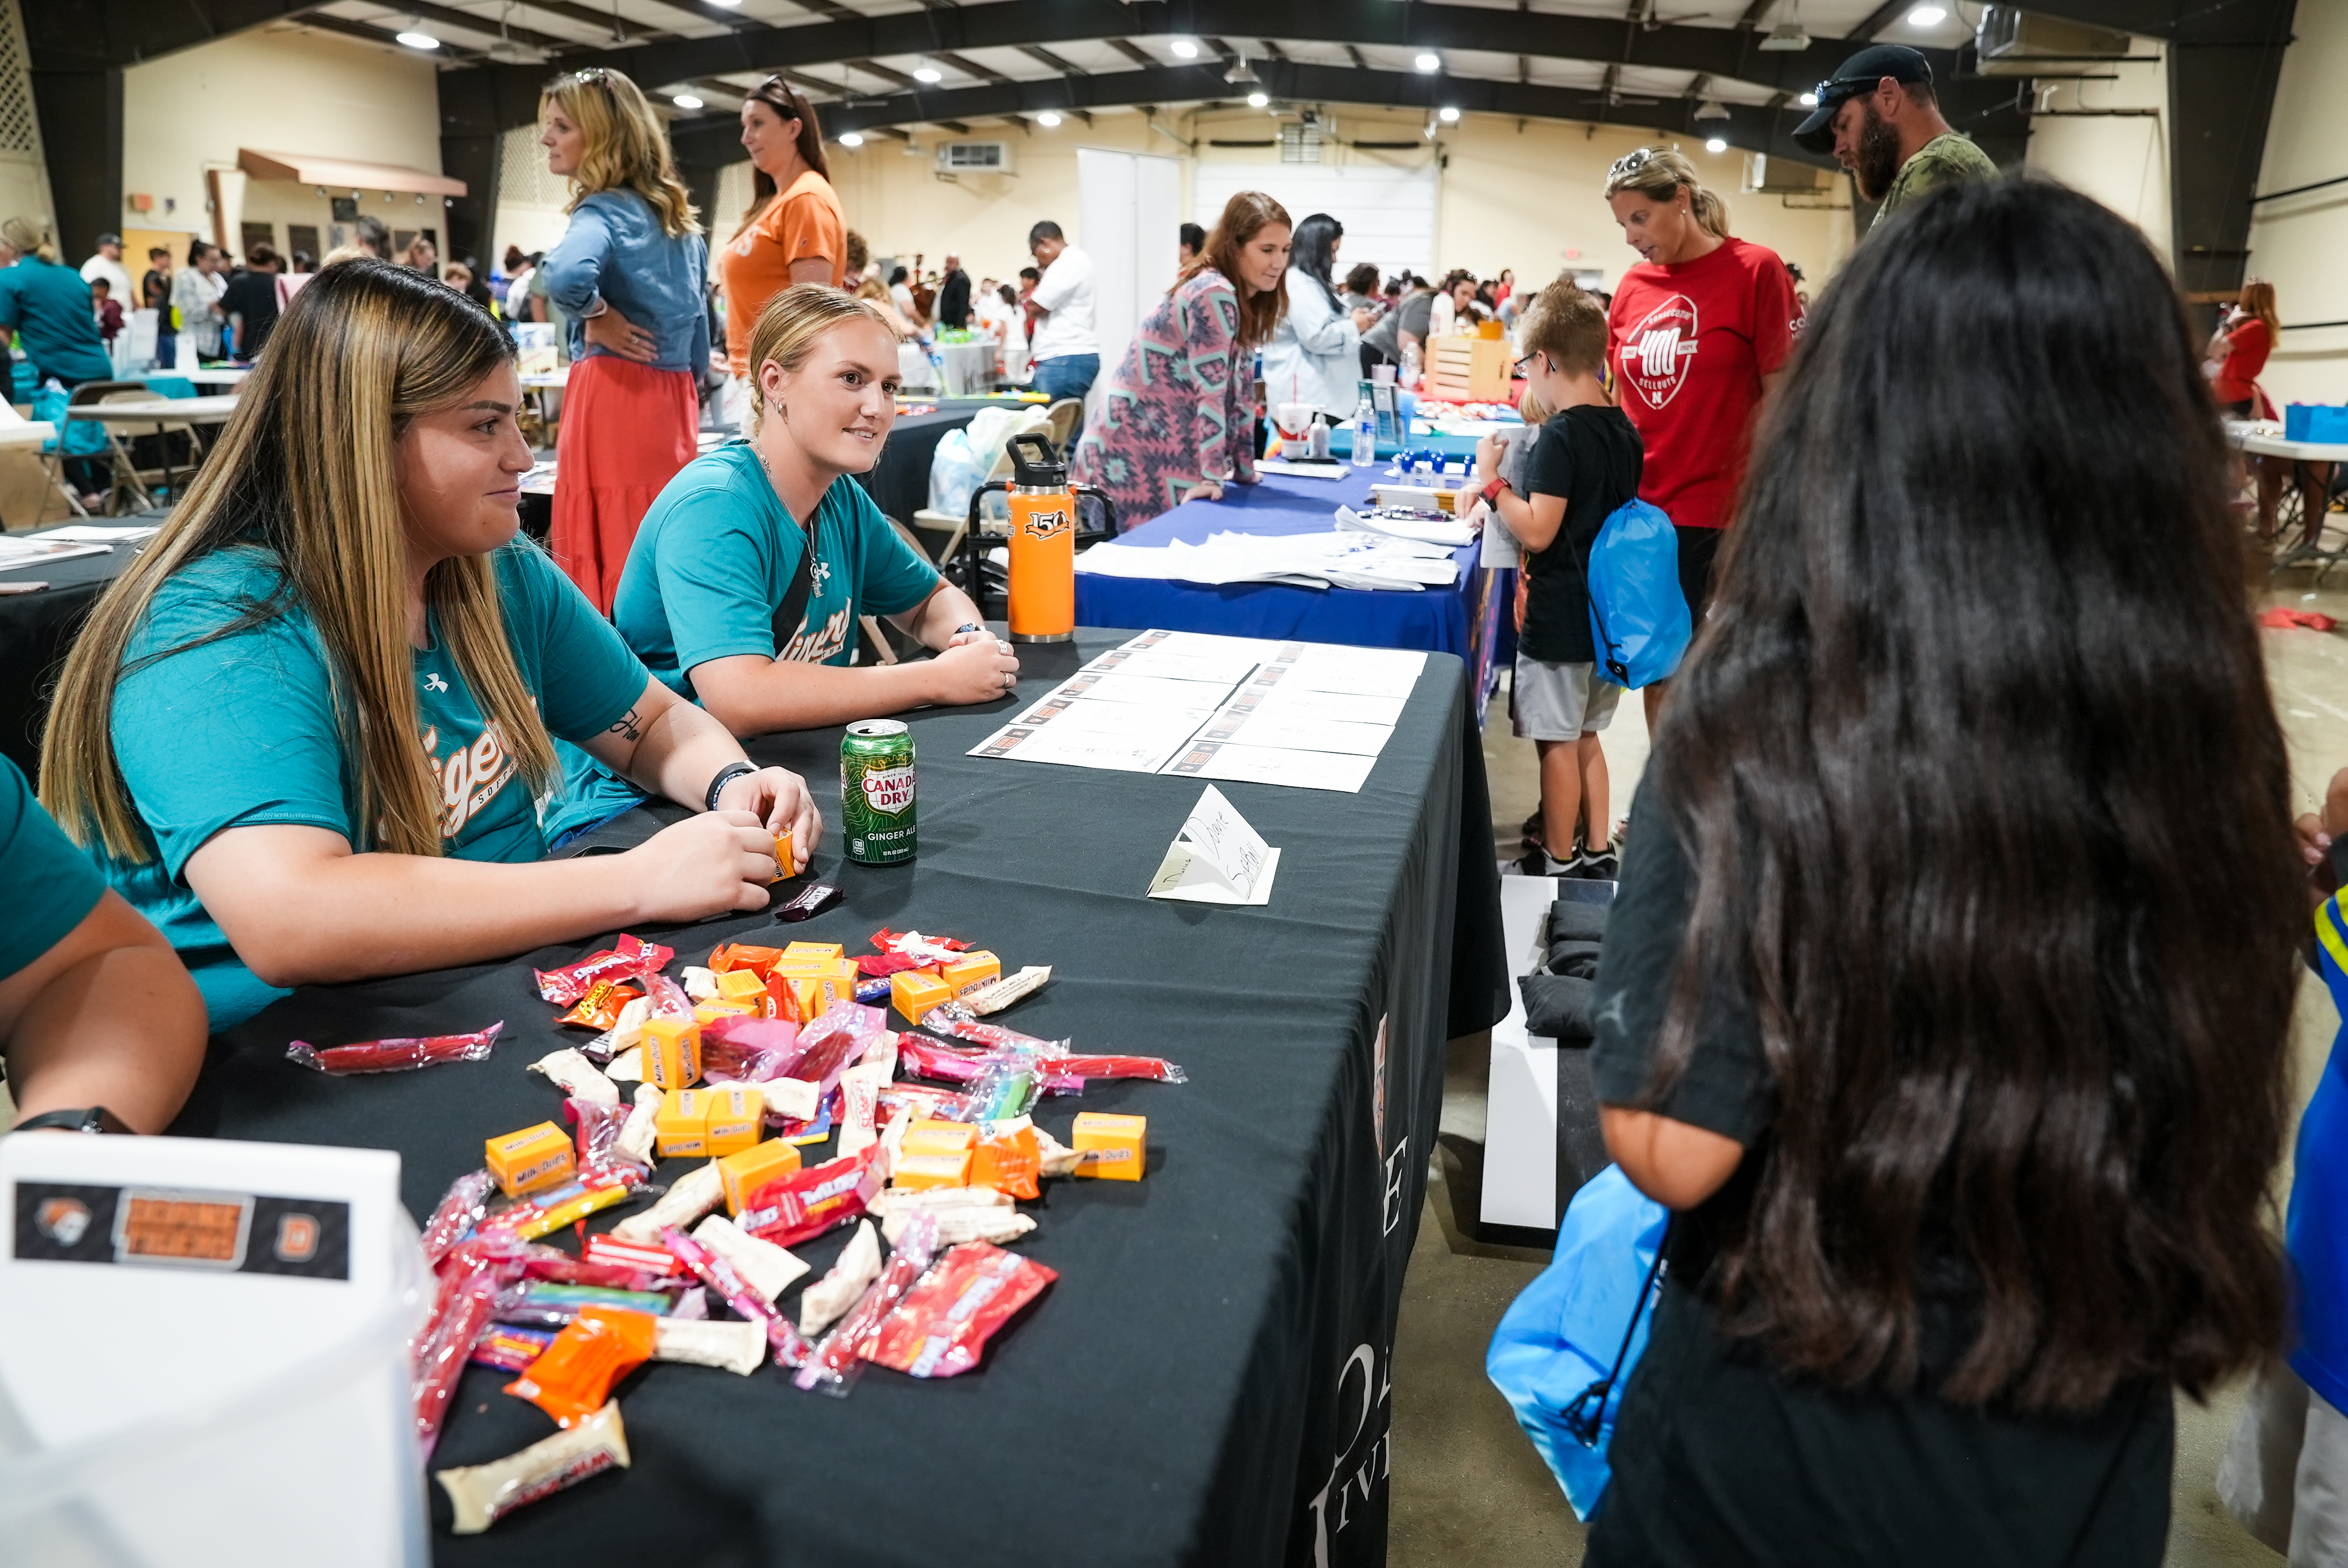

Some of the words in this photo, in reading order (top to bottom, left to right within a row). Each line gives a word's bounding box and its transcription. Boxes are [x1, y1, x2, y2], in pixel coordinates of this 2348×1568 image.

[1638, 327, 1681, 376] 400
[1639, 375, 1676, 390] SELLOUTS
[1652, 391, 1662, 404] N
[863, 772, 916, 792] CANADA
[868, 831, 904, 840] GINGER
[906, 825, 916, 836] ALE
[959, 984, 978, 996] Duds
[981, 975, 997, 987] Milk
[825, 981, 835, 1002] Duds
[651, 1036, 661, 1060] Duds
[682, 1039, 691, 1060] Duds
[655, 1062, 665, 1082] Milk
[517, 1167, 538, 1183] Milk
[542, 1154, 567, 1171] Duds
